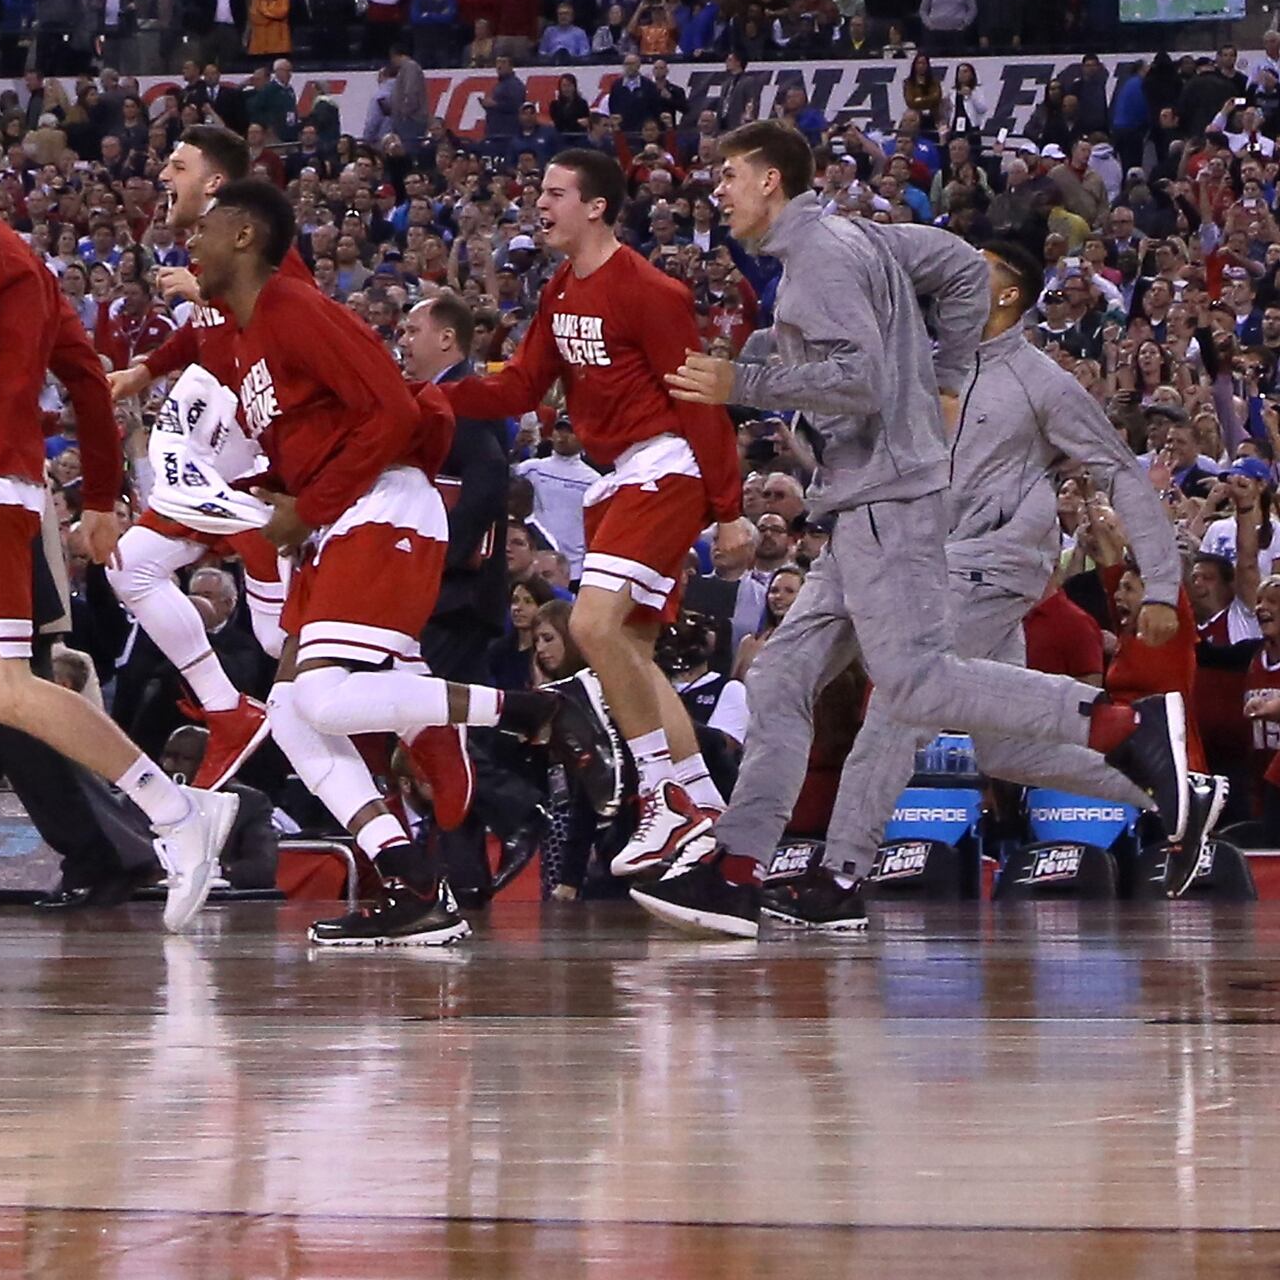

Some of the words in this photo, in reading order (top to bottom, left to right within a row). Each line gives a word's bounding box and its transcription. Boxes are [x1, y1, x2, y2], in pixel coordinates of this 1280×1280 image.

[678, 66, 948, 130] FNA
[891, 807, 968, 822] WERADE
[1031, 806, 1125, 822] POWERADE
[883, 853, 926, 873] FOUR
[1036, 855, 1080, 876] FOUR
